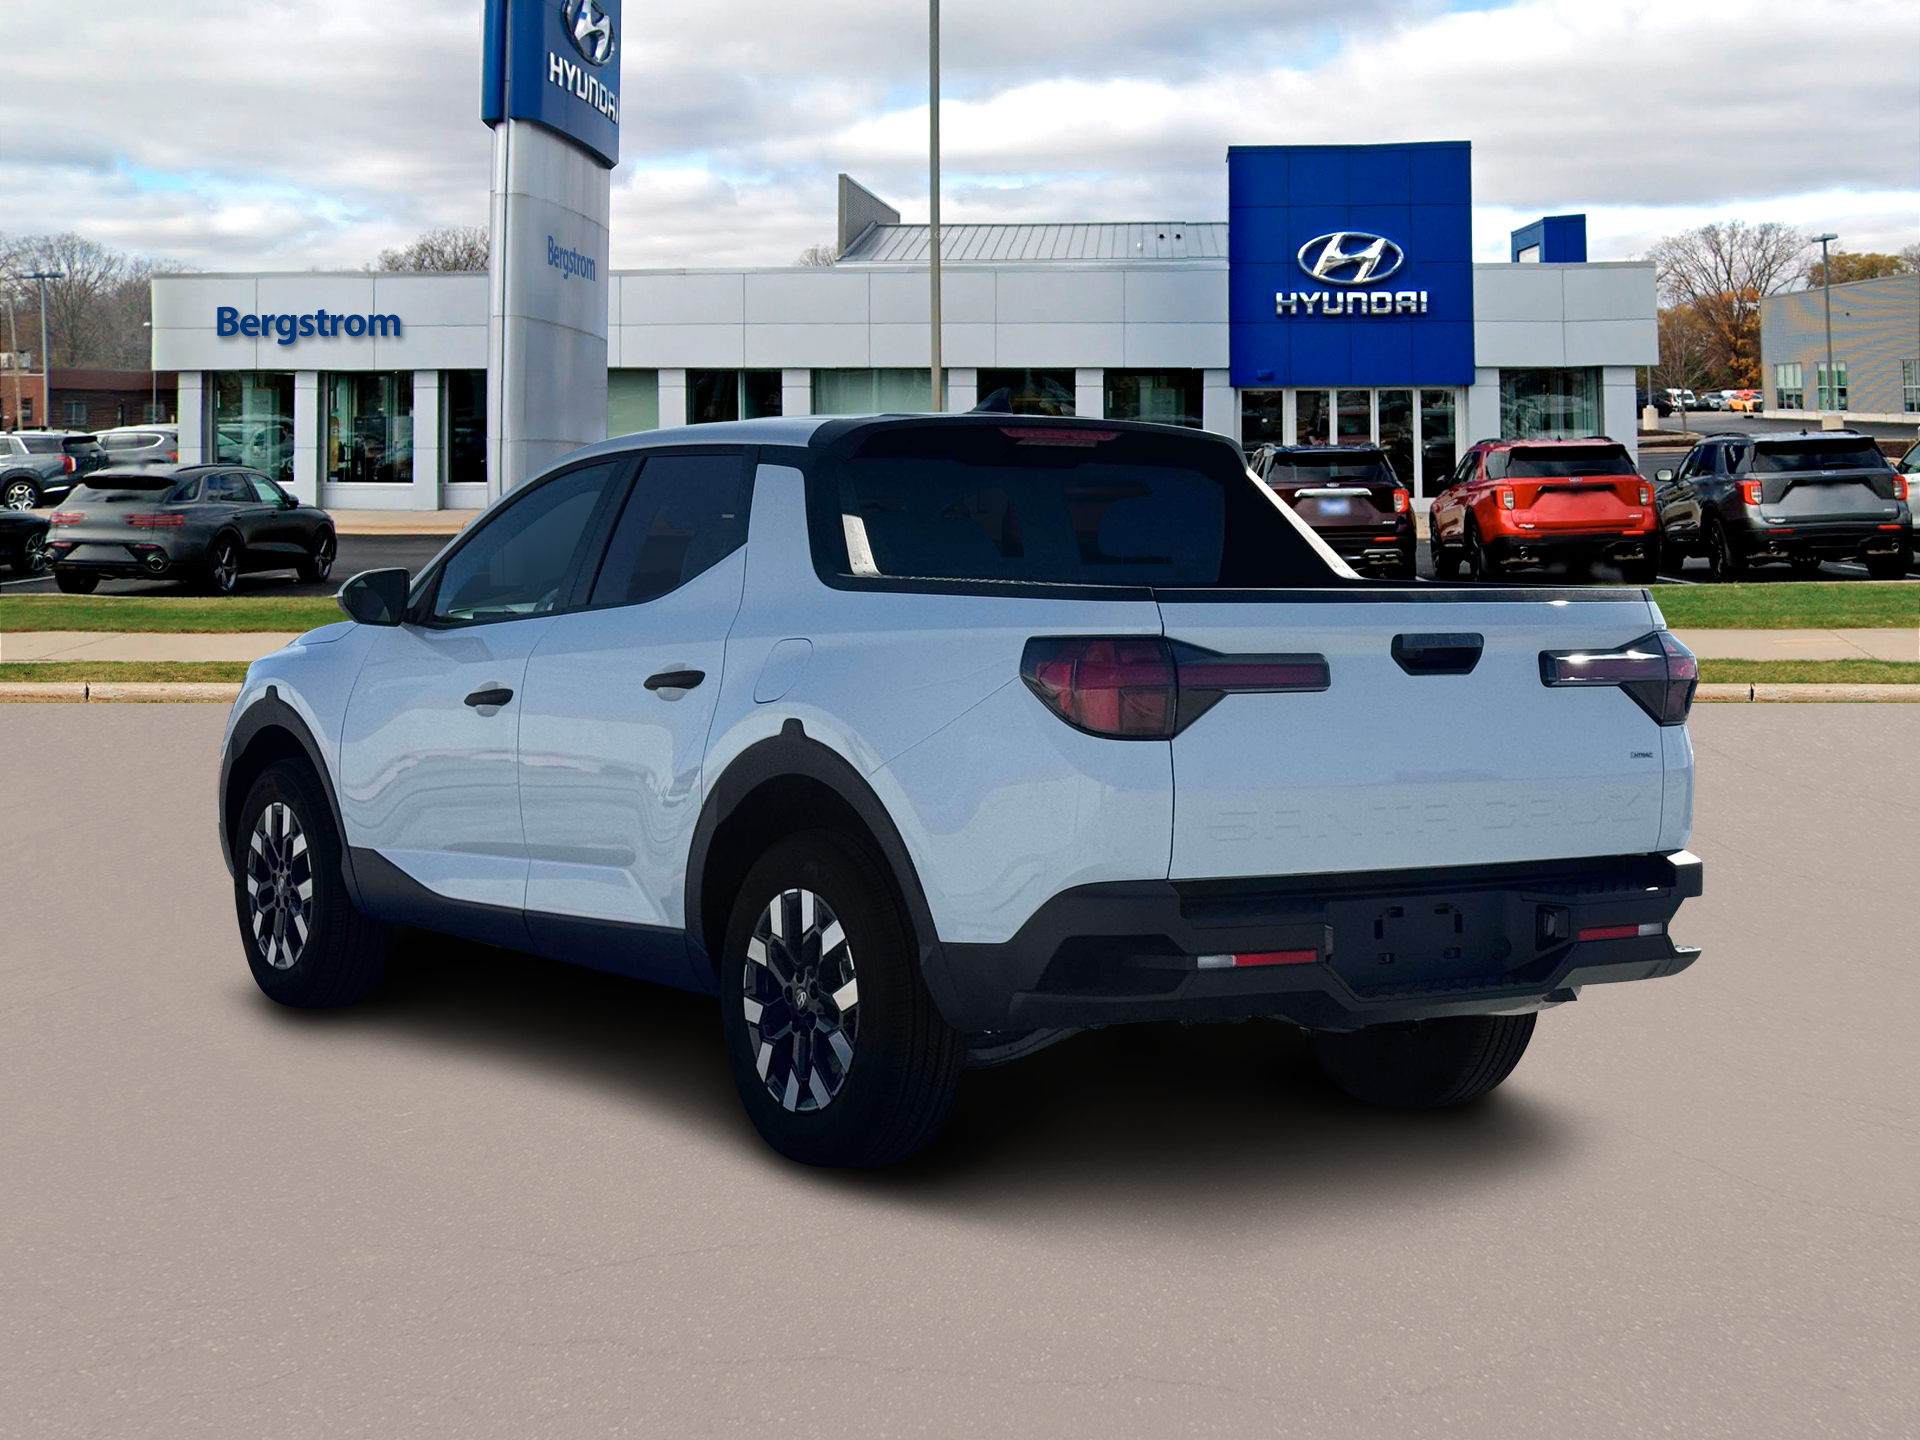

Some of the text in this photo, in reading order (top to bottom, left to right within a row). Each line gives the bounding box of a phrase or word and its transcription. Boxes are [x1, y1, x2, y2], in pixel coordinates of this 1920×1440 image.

[548, 52, 619, 124] HYUNDAI
[547, 235, 596, 281] Bergstrom
[1275, 290, 1428, 315] HYUNDAI
[216, 306, 401, 346] Bergstrom
